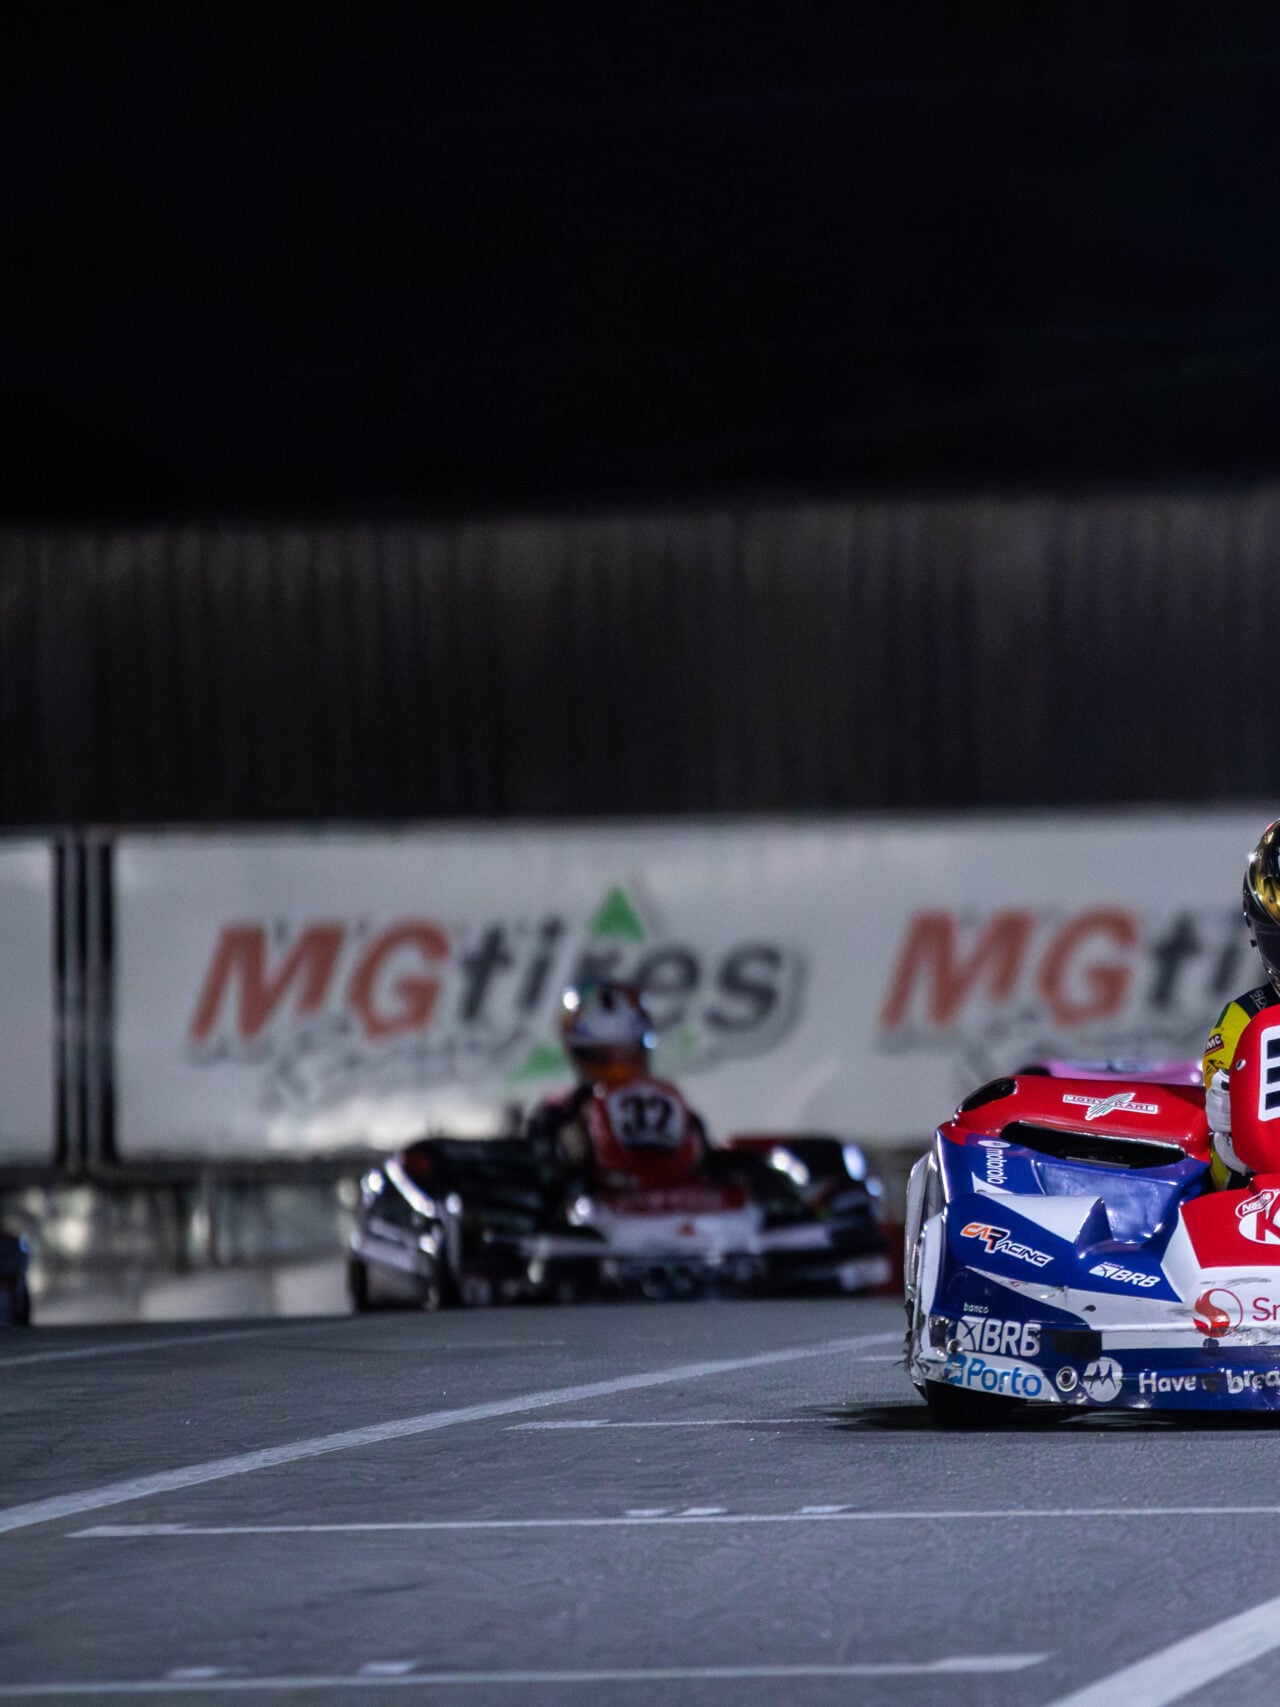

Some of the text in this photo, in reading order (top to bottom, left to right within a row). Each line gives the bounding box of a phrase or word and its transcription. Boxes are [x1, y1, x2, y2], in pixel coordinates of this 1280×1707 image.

[1110, 1269, 1161, 1288] BRB
[963, 1302, 990, 1314] banco
[981, 1318, 1042, 1357] BRB
[967, 1358, 1043, 1397] Porto
[1138, 1371, 1197, 1394] Have
